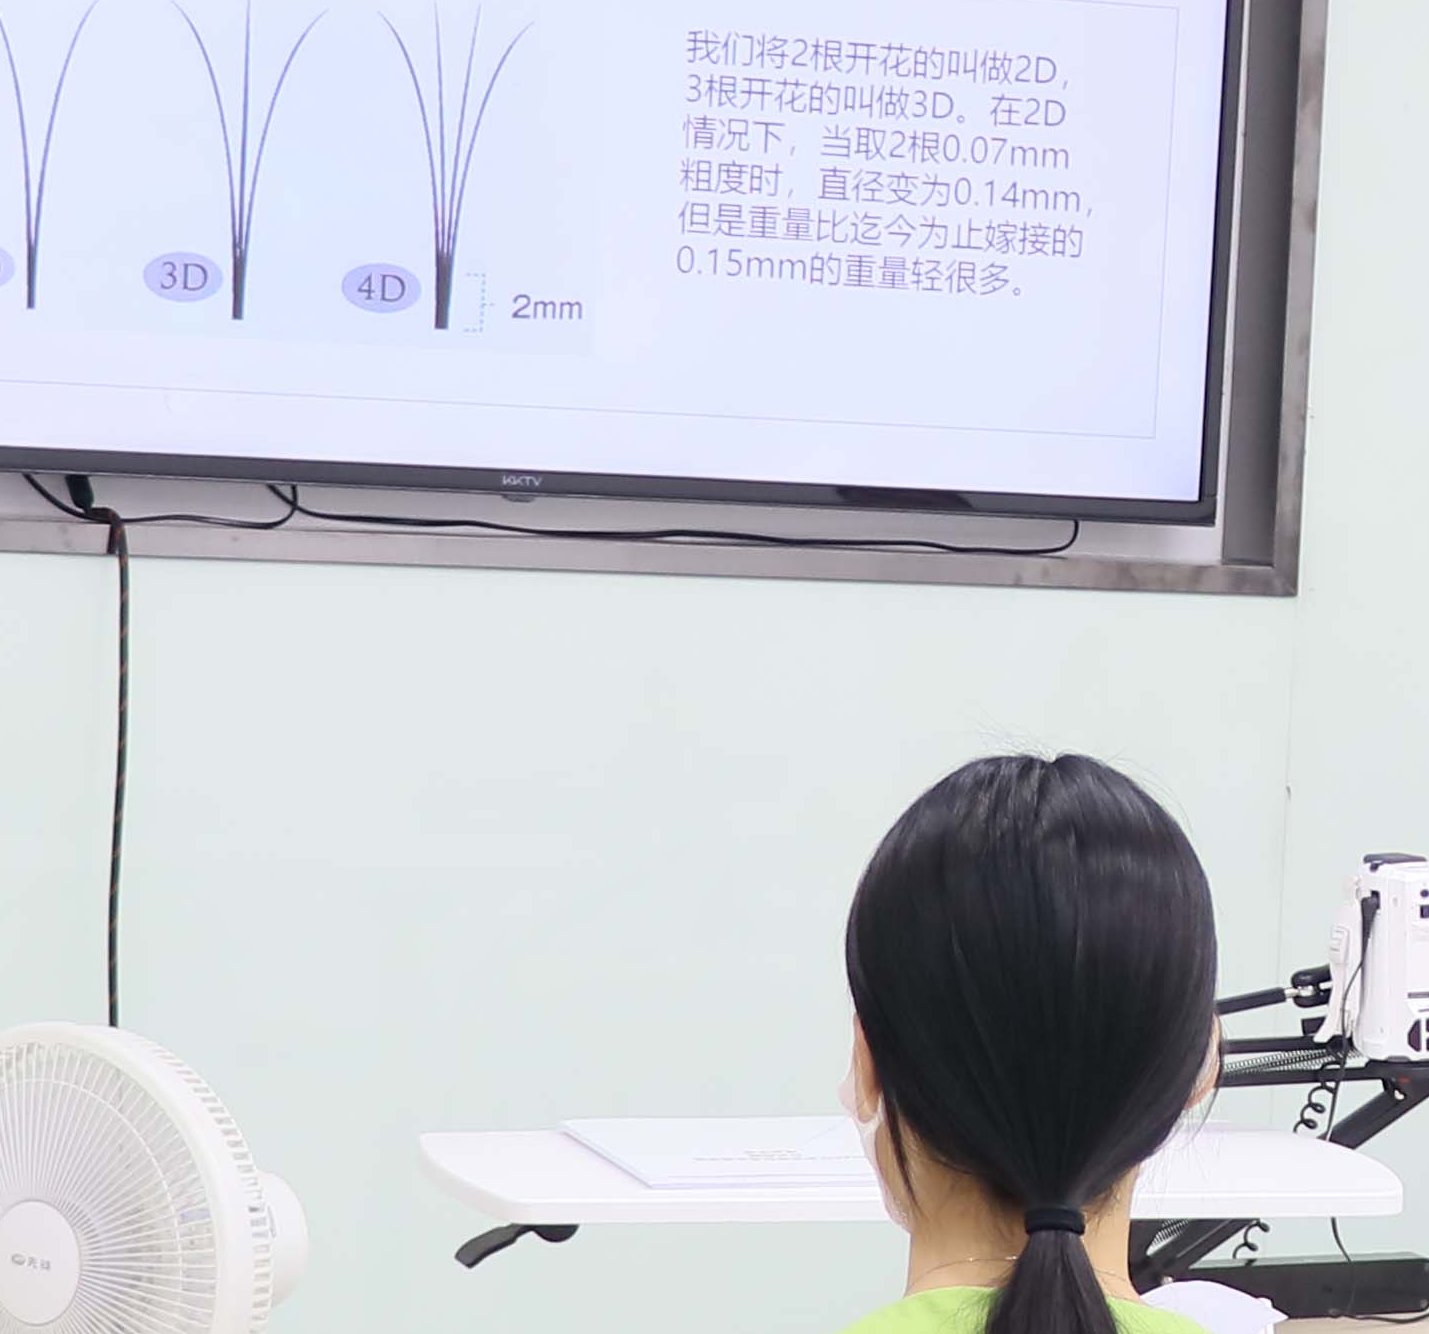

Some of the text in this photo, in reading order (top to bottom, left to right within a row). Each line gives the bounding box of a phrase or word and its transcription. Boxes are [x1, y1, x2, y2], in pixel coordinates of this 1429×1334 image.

[678, 200, 1083, 258] 但是重量比迄今为止嫁接的
[159, 261, 208, 292] 3D
[357, 272, 406, 303] 4D
[511, 293, 583, 321] 2mm
[502, 474, 543, 487] KKTV
